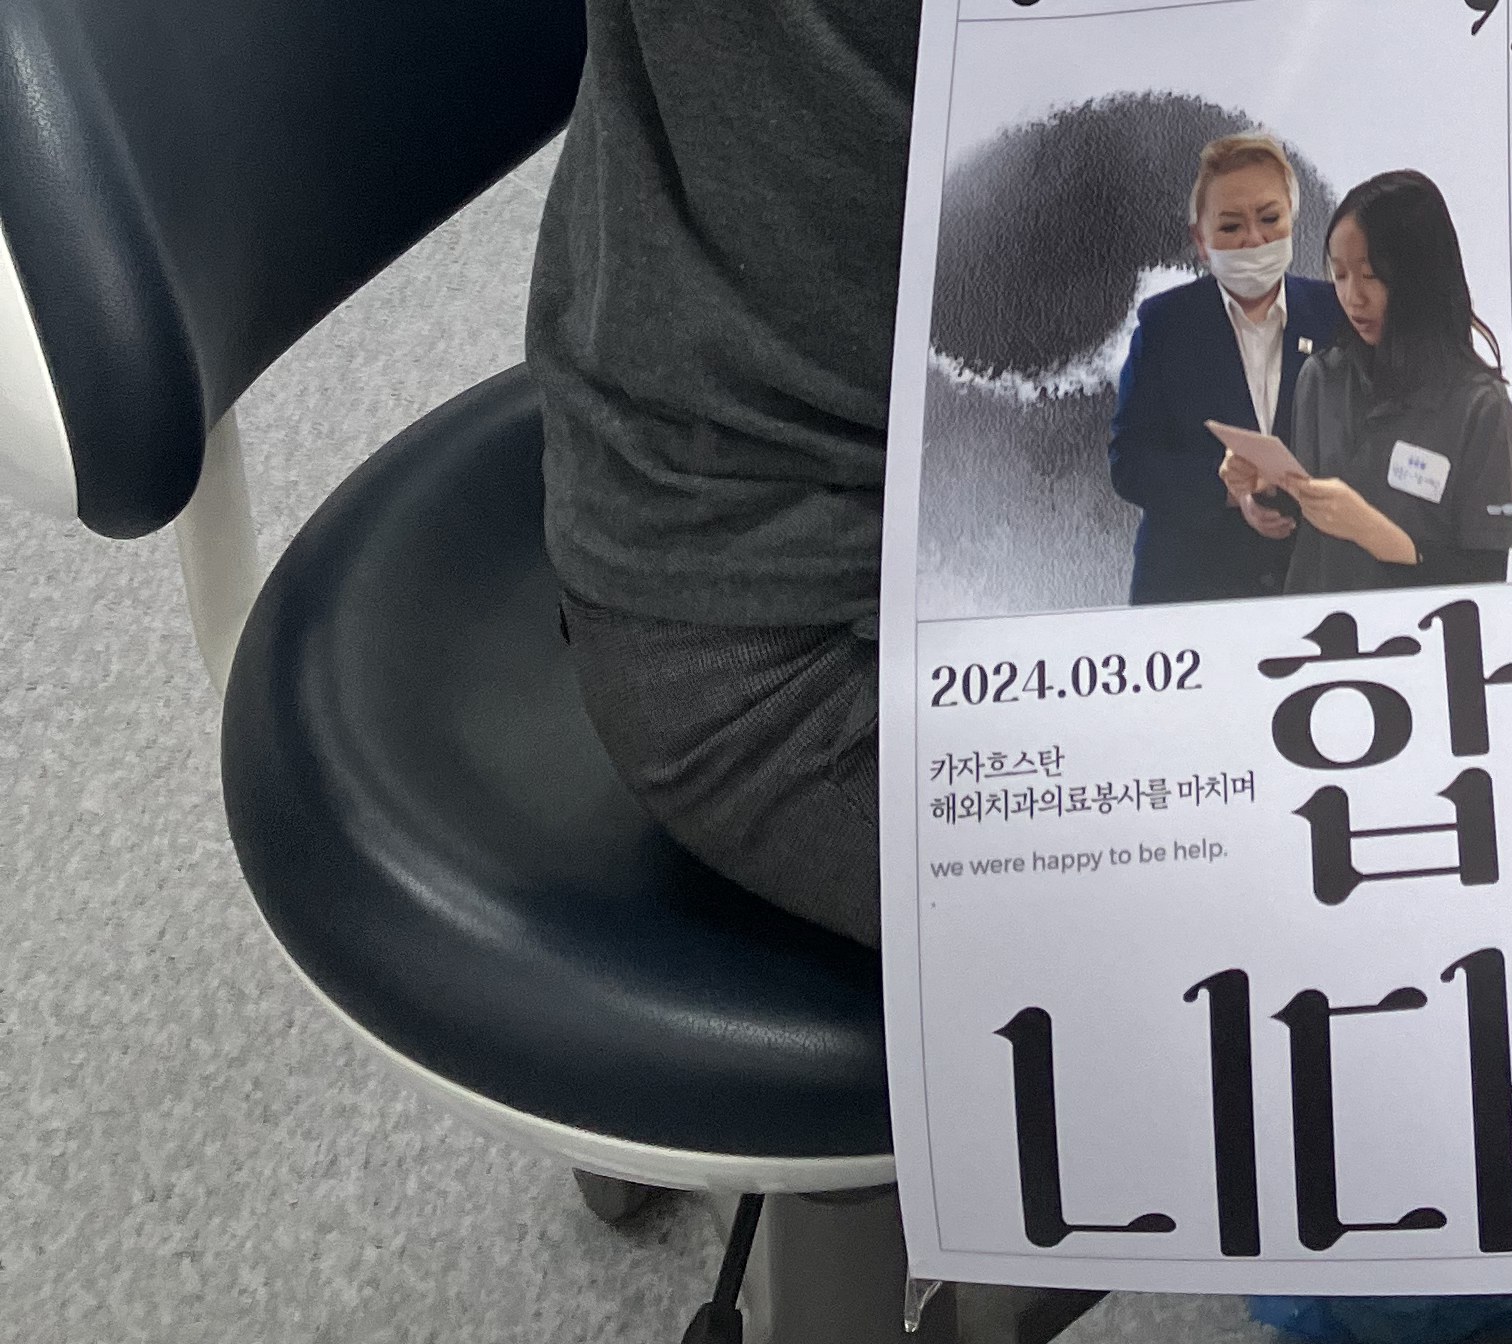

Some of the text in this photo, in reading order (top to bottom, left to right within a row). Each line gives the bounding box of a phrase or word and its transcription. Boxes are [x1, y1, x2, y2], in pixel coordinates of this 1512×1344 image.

[930, 648, 1203, 708] 2024.03.02
[929, 744, 1066, 786] 카자흐스탄
[929, 769, 1255, 826] 해외치과의료봉사를 마치며
[929, 837, 1228, 880] we were happy to be help.
